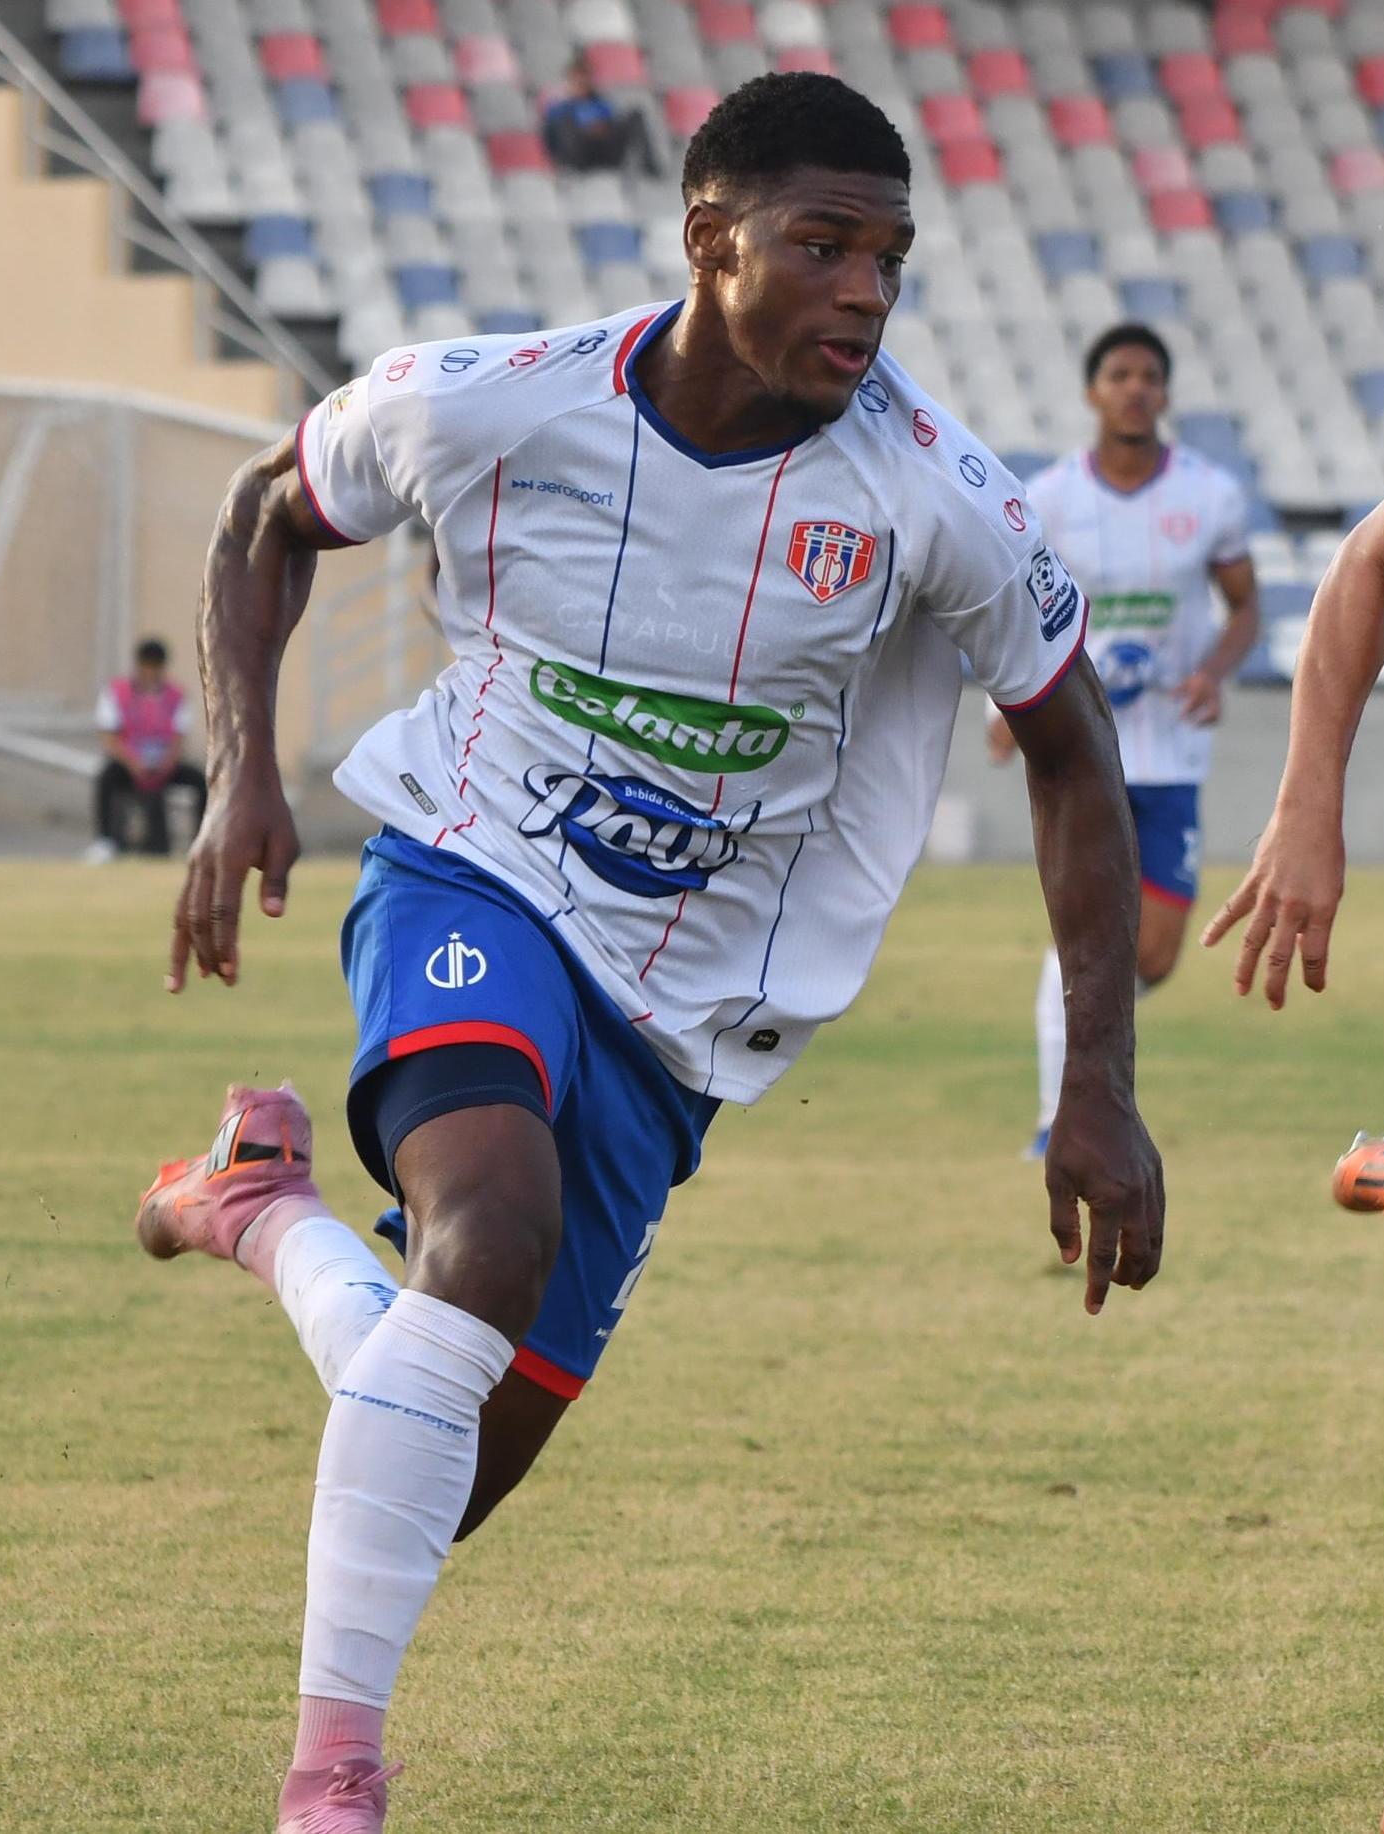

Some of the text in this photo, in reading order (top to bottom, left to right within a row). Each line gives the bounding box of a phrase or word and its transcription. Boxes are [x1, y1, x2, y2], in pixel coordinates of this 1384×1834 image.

[537, 481, 614, 506] aerosport
[537, 665, 782, 756] Colanta
[625, 785, 663, 805] Bebida
